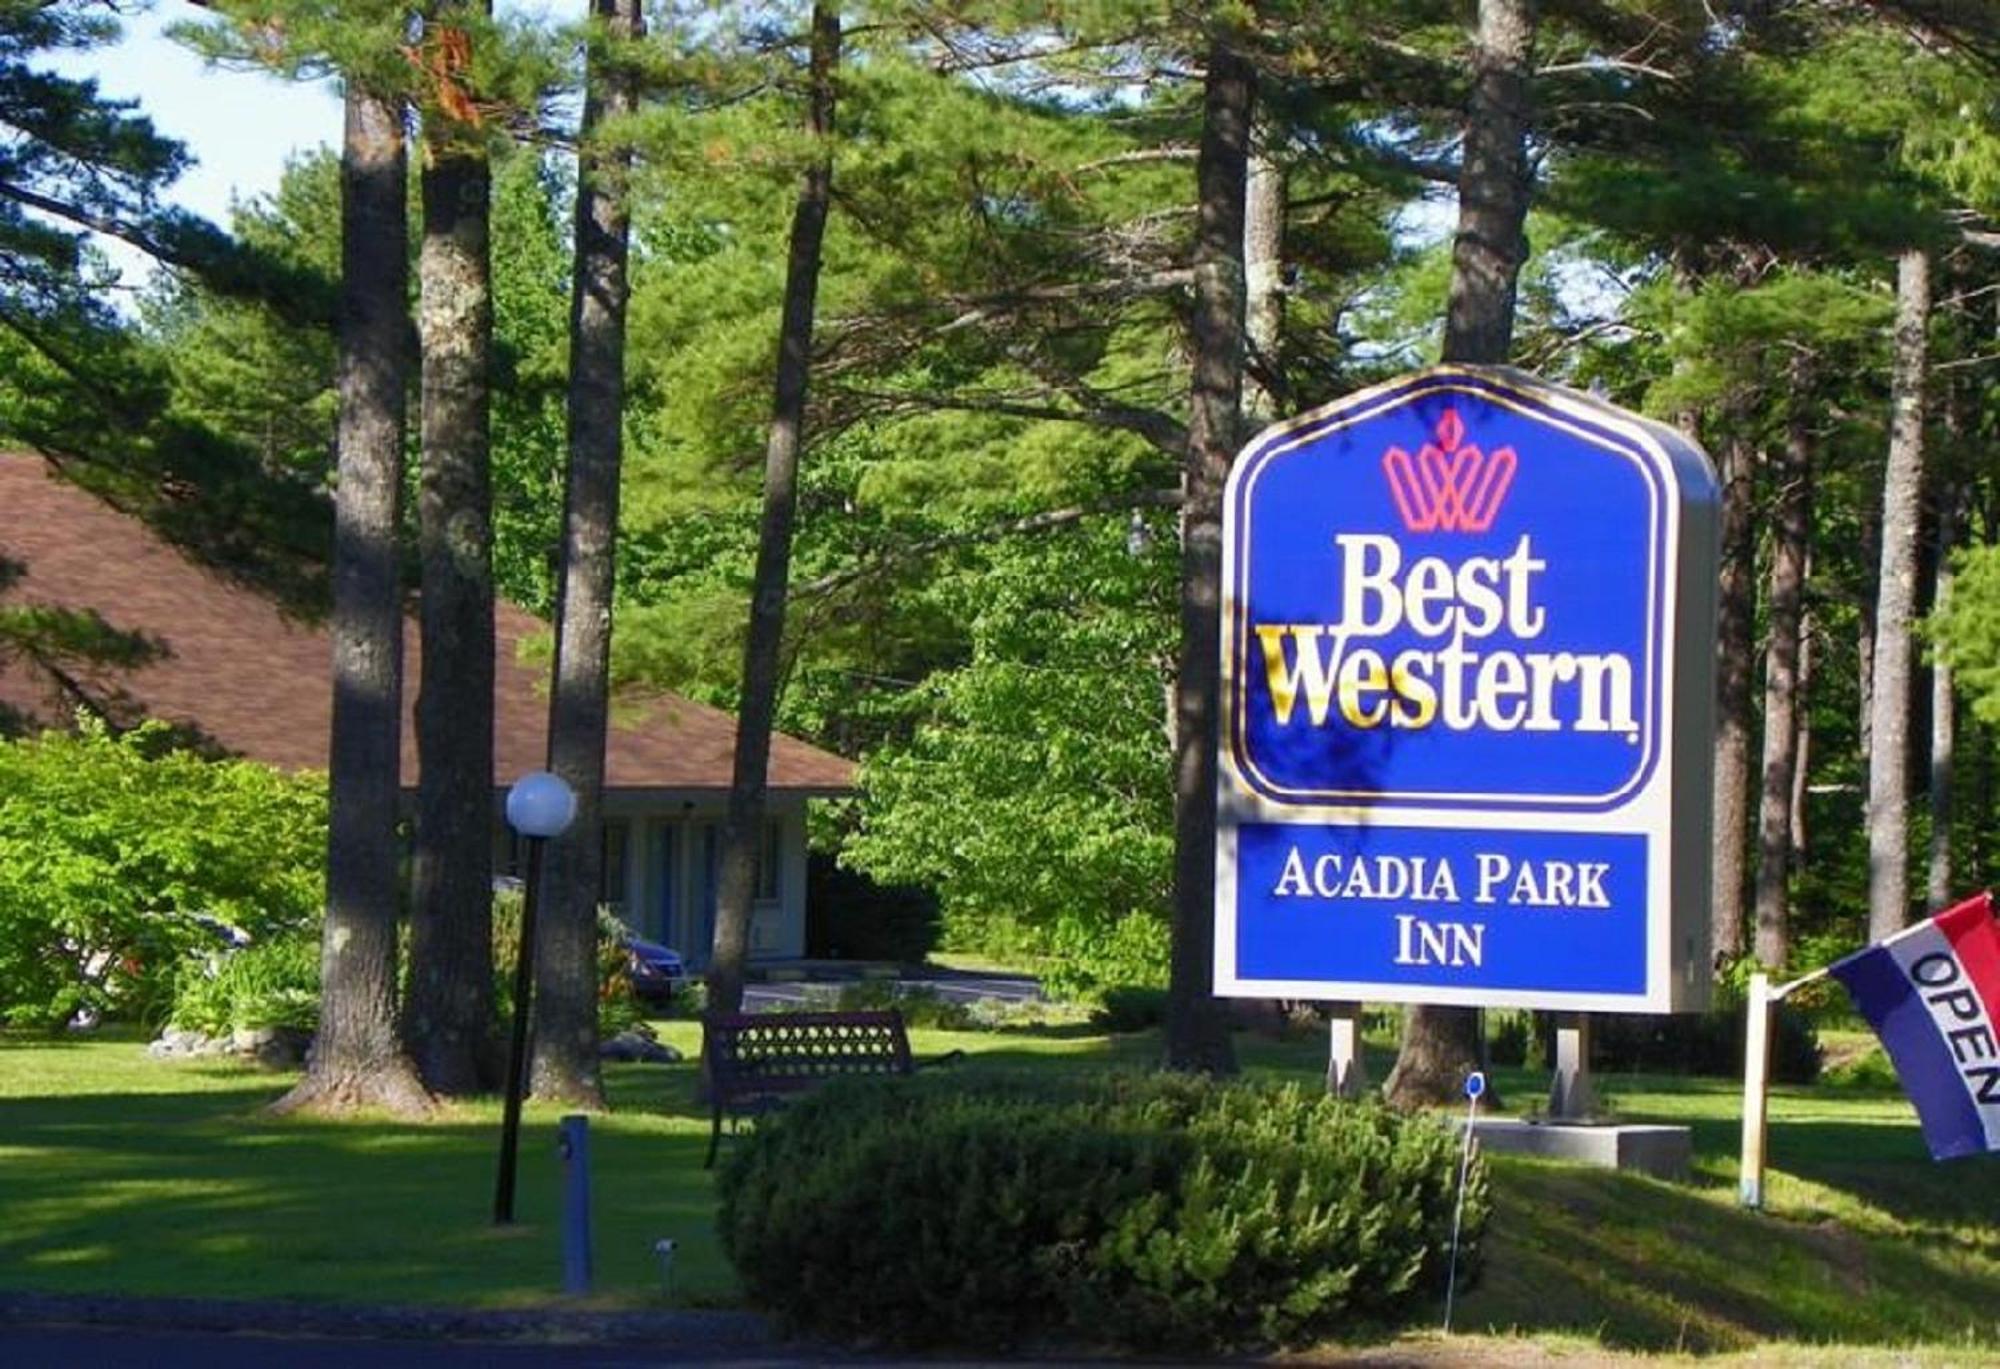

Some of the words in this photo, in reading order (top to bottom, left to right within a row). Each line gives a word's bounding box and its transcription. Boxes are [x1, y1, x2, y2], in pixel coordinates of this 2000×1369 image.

[1335, 534, 1546, 637] Best
[1255, 608, 1638, 732] Western
[1276, 847, 1459, 901] ACADIA
[1476, 855, 1611, 908] PARK
[1395, 915, 1486, 967] INN
[1911, 953, 2000, 1104] OPEN
